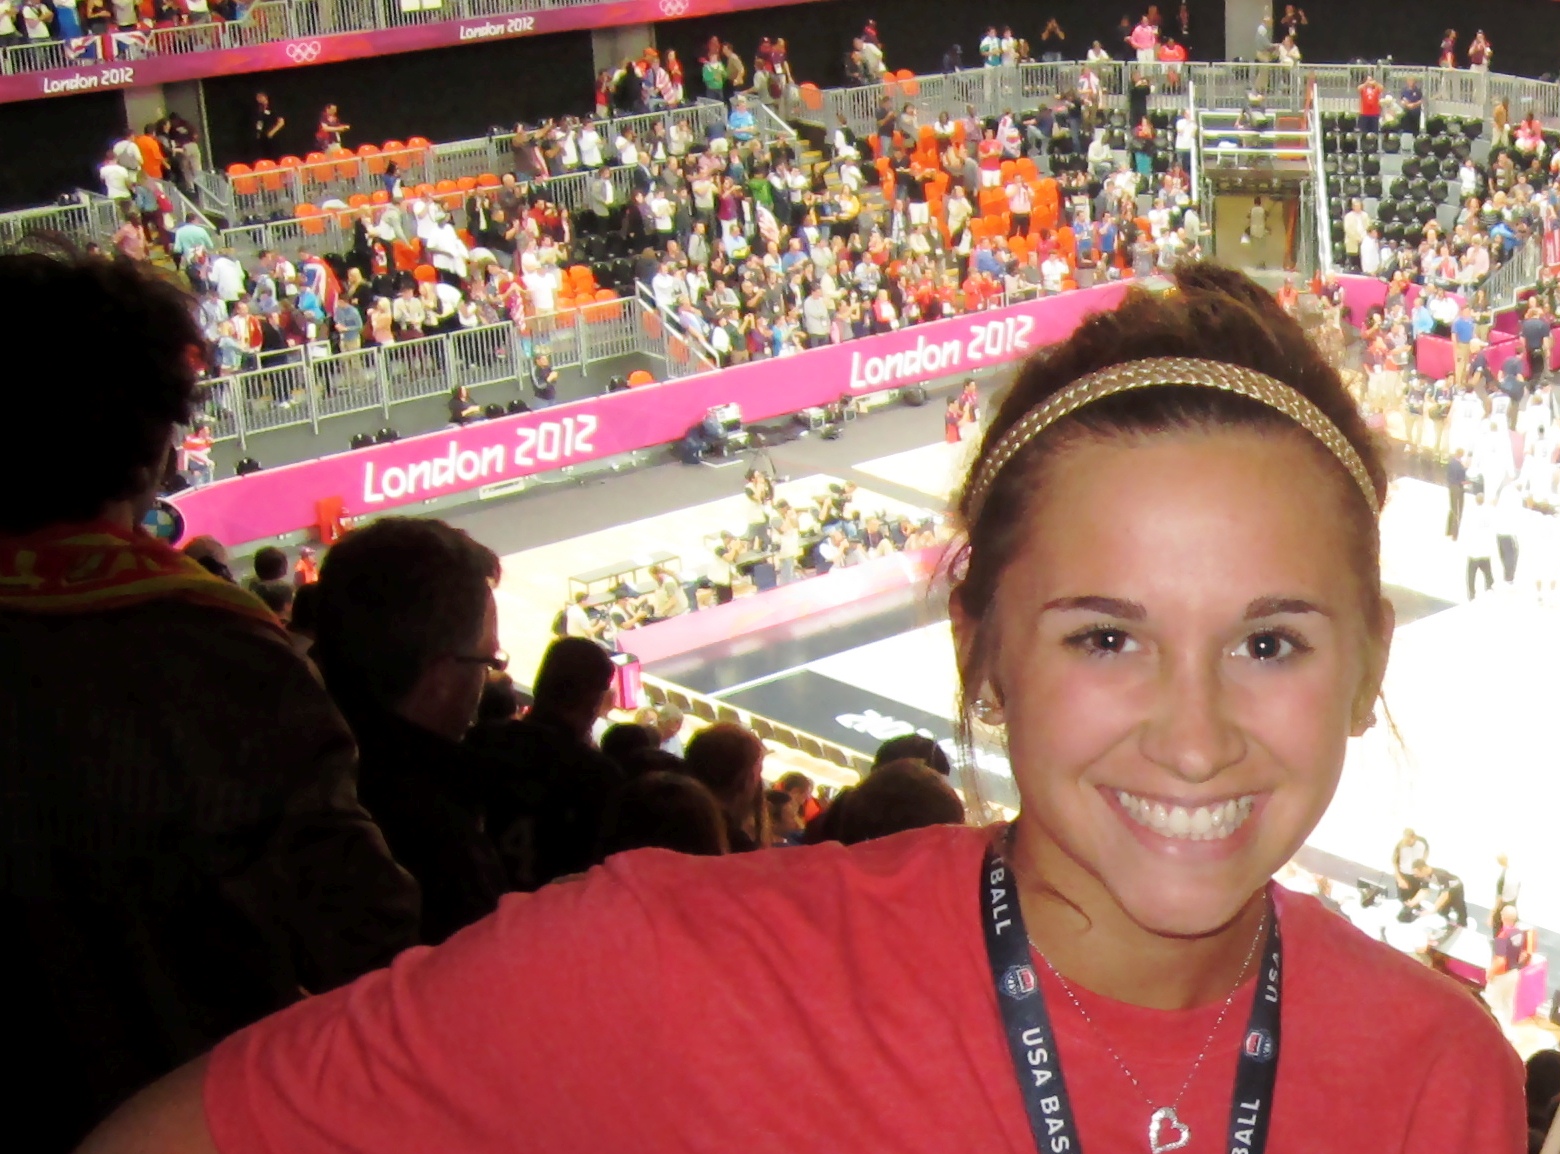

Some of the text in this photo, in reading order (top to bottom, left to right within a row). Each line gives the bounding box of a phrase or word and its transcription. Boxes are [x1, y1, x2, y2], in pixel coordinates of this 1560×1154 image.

[460, 16, 535, 40] London 2012
[44, 67, 134, 94] London 2012
[850, 314, 1034, 388] London 2012
[364, 414, 598, 503] London 2012
[1022, 1026, 1053, 1088] USA
